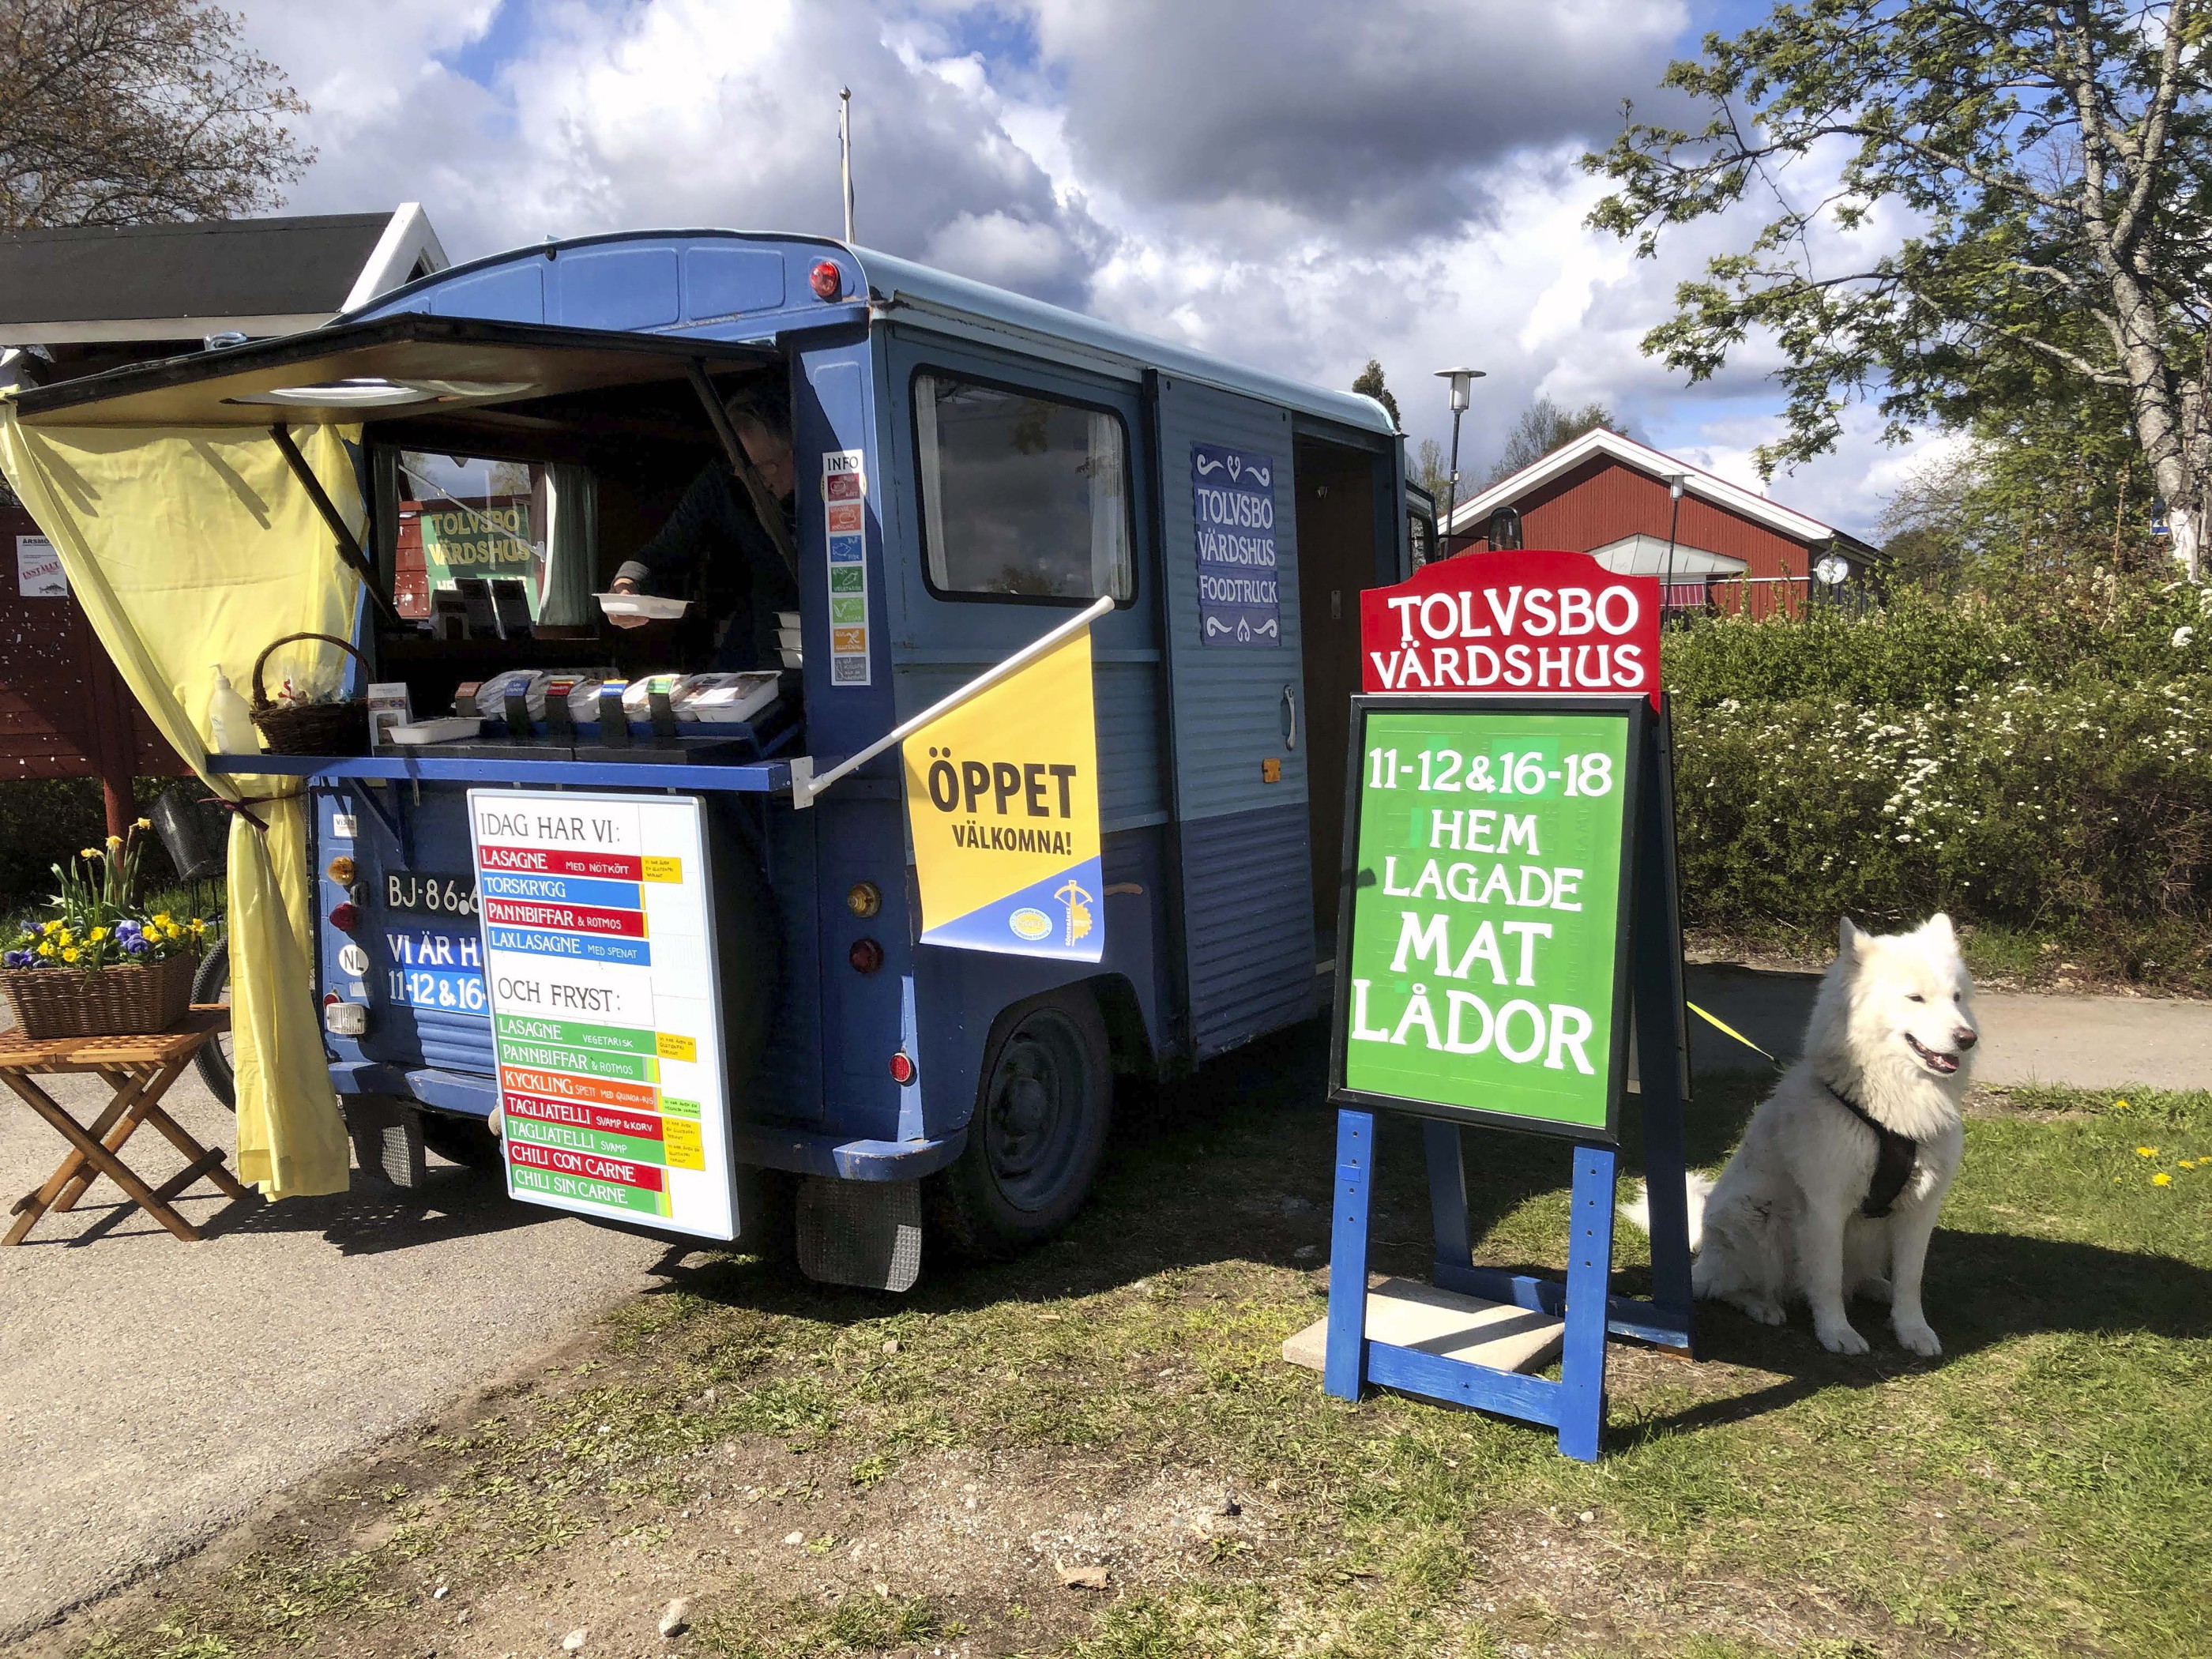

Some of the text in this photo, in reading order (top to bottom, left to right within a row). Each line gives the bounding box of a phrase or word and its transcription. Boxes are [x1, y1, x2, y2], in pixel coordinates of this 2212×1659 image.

[827, 456, 858, 471] INFO
[431, 510, 520, 536] TOLVSBO
[1198, 488, 1273, 529] TOLVSBO
[428, 538, 530, 566] VÄRDSHUS
[1198, 527, 1276, 566] VÄRDSHUS
[1199, 574, 1277, 603] FOODTRUCK
[1387, 585, 1639, 641] TOLVSBO
[1370, 640, 1645, 689] VÄRDSHUS
[928, 747, 1077, 818] ÖPPET
[480, 813, 620, 843] IDAG HAR VI:
[951, 820, 1072, 856] VÄLKOMNA!
[1428, 809, 1541, 856] HEM
[482, 848, 630, 875] LASAGNE MED NÖTKÖTT
[484, 877, 566, 897] TORSKRYGG
[1382, 856, 1584, 912] LAGADE
[488, 902, 622, 930] PANNBIFFAR & ROTMOS
[345, 950, 364, 972] NL
[387, 934, 412, 965] VI
[418, 930, 454, 965] ÄR
[491, 931, 638, 959] LAXLASAGNE MED SPENAT
[1389, 911, 1554, 987] MAT
[389, 970, 434, 1005] 11-12
[438, 979, 457, 1007] &
[498, 977, 621, 1012] OCH FRYST:
[498, 1018, 633, 1048] LASAGNE VEGETARISK
[1351, 979, 1595, 1075] LÅDOR
[502, 1044, 634, 1075] PANNBIFFAR & ROTMOS
[504, 1070, 654, 1105] KYCKLING SPETT MED QUINOA-RIS
[507, 1097, 591, 1125] TAGLIATELLI
[596, 1115, 622, 1129] SVAMP
[510, 1120, 627, 1154] TAGLIATELLI SVAMP
[512, 1146, 636, 1183] CHILI CON CARNE
[515, 1169, 628, 1205] CHILI SIN CARNE
